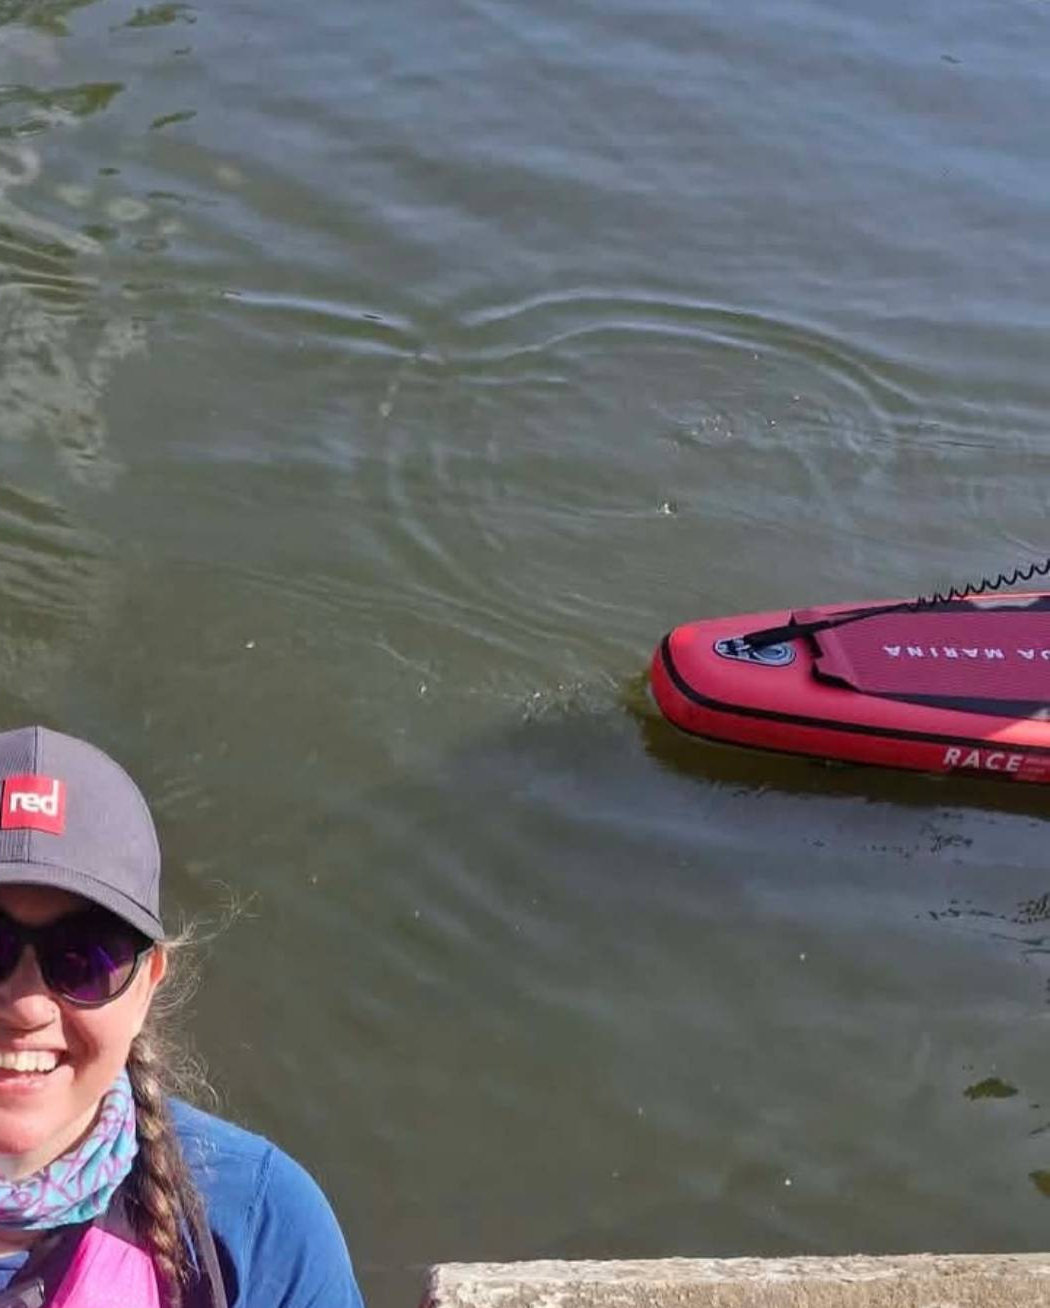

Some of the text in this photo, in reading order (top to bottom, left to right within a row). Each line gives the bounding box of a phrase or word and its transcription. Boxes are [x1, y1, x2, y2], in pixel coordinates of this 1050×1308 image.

[882, 645, 1005, 660] MARINA
[942, 746, 1024, 773] RACE
[10, 780, 60, 817] red
